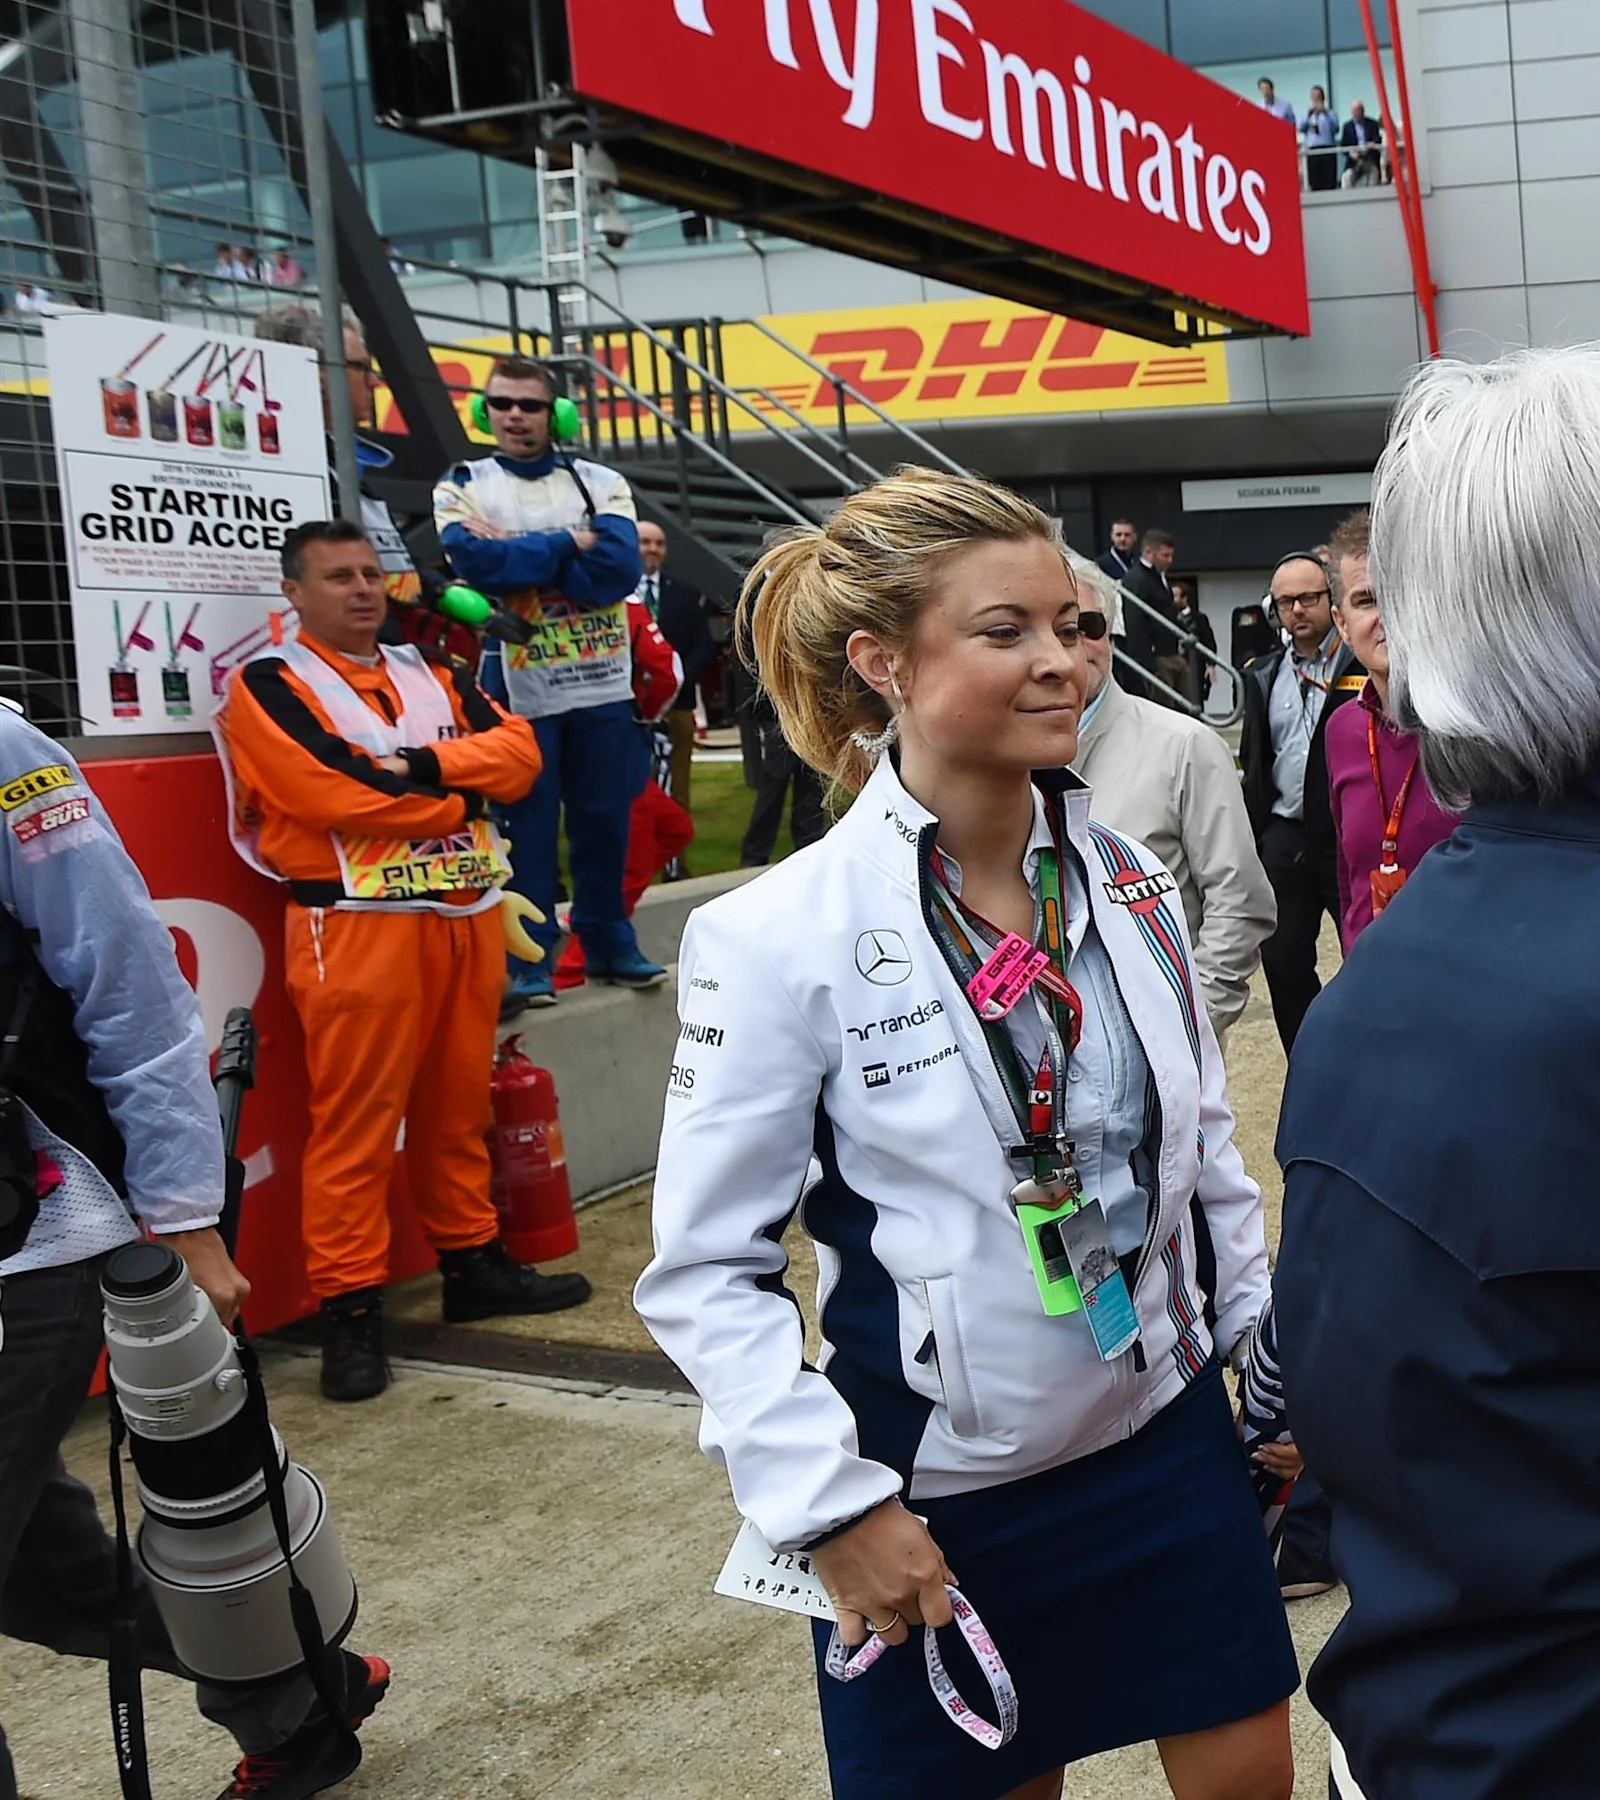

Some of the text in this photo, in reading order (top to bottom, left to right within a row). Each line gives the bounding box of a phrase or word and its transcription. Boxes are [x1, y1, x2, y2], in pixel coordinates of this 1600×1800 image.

[911, 0, 1271, 255] Emirates
[811, 314, 1139, 408] DHL
[110, 483, 293, 523] STARTING
[80, 512, 174, 543] GRID
[382, 861, 432, 884] PIT
[985, 936, 1024, 980] GRID
[866, 1069, 888, 1084] BR
[966, 1621, 996, 1655] VIP
[117, 1702, 132, 1769] Canon
